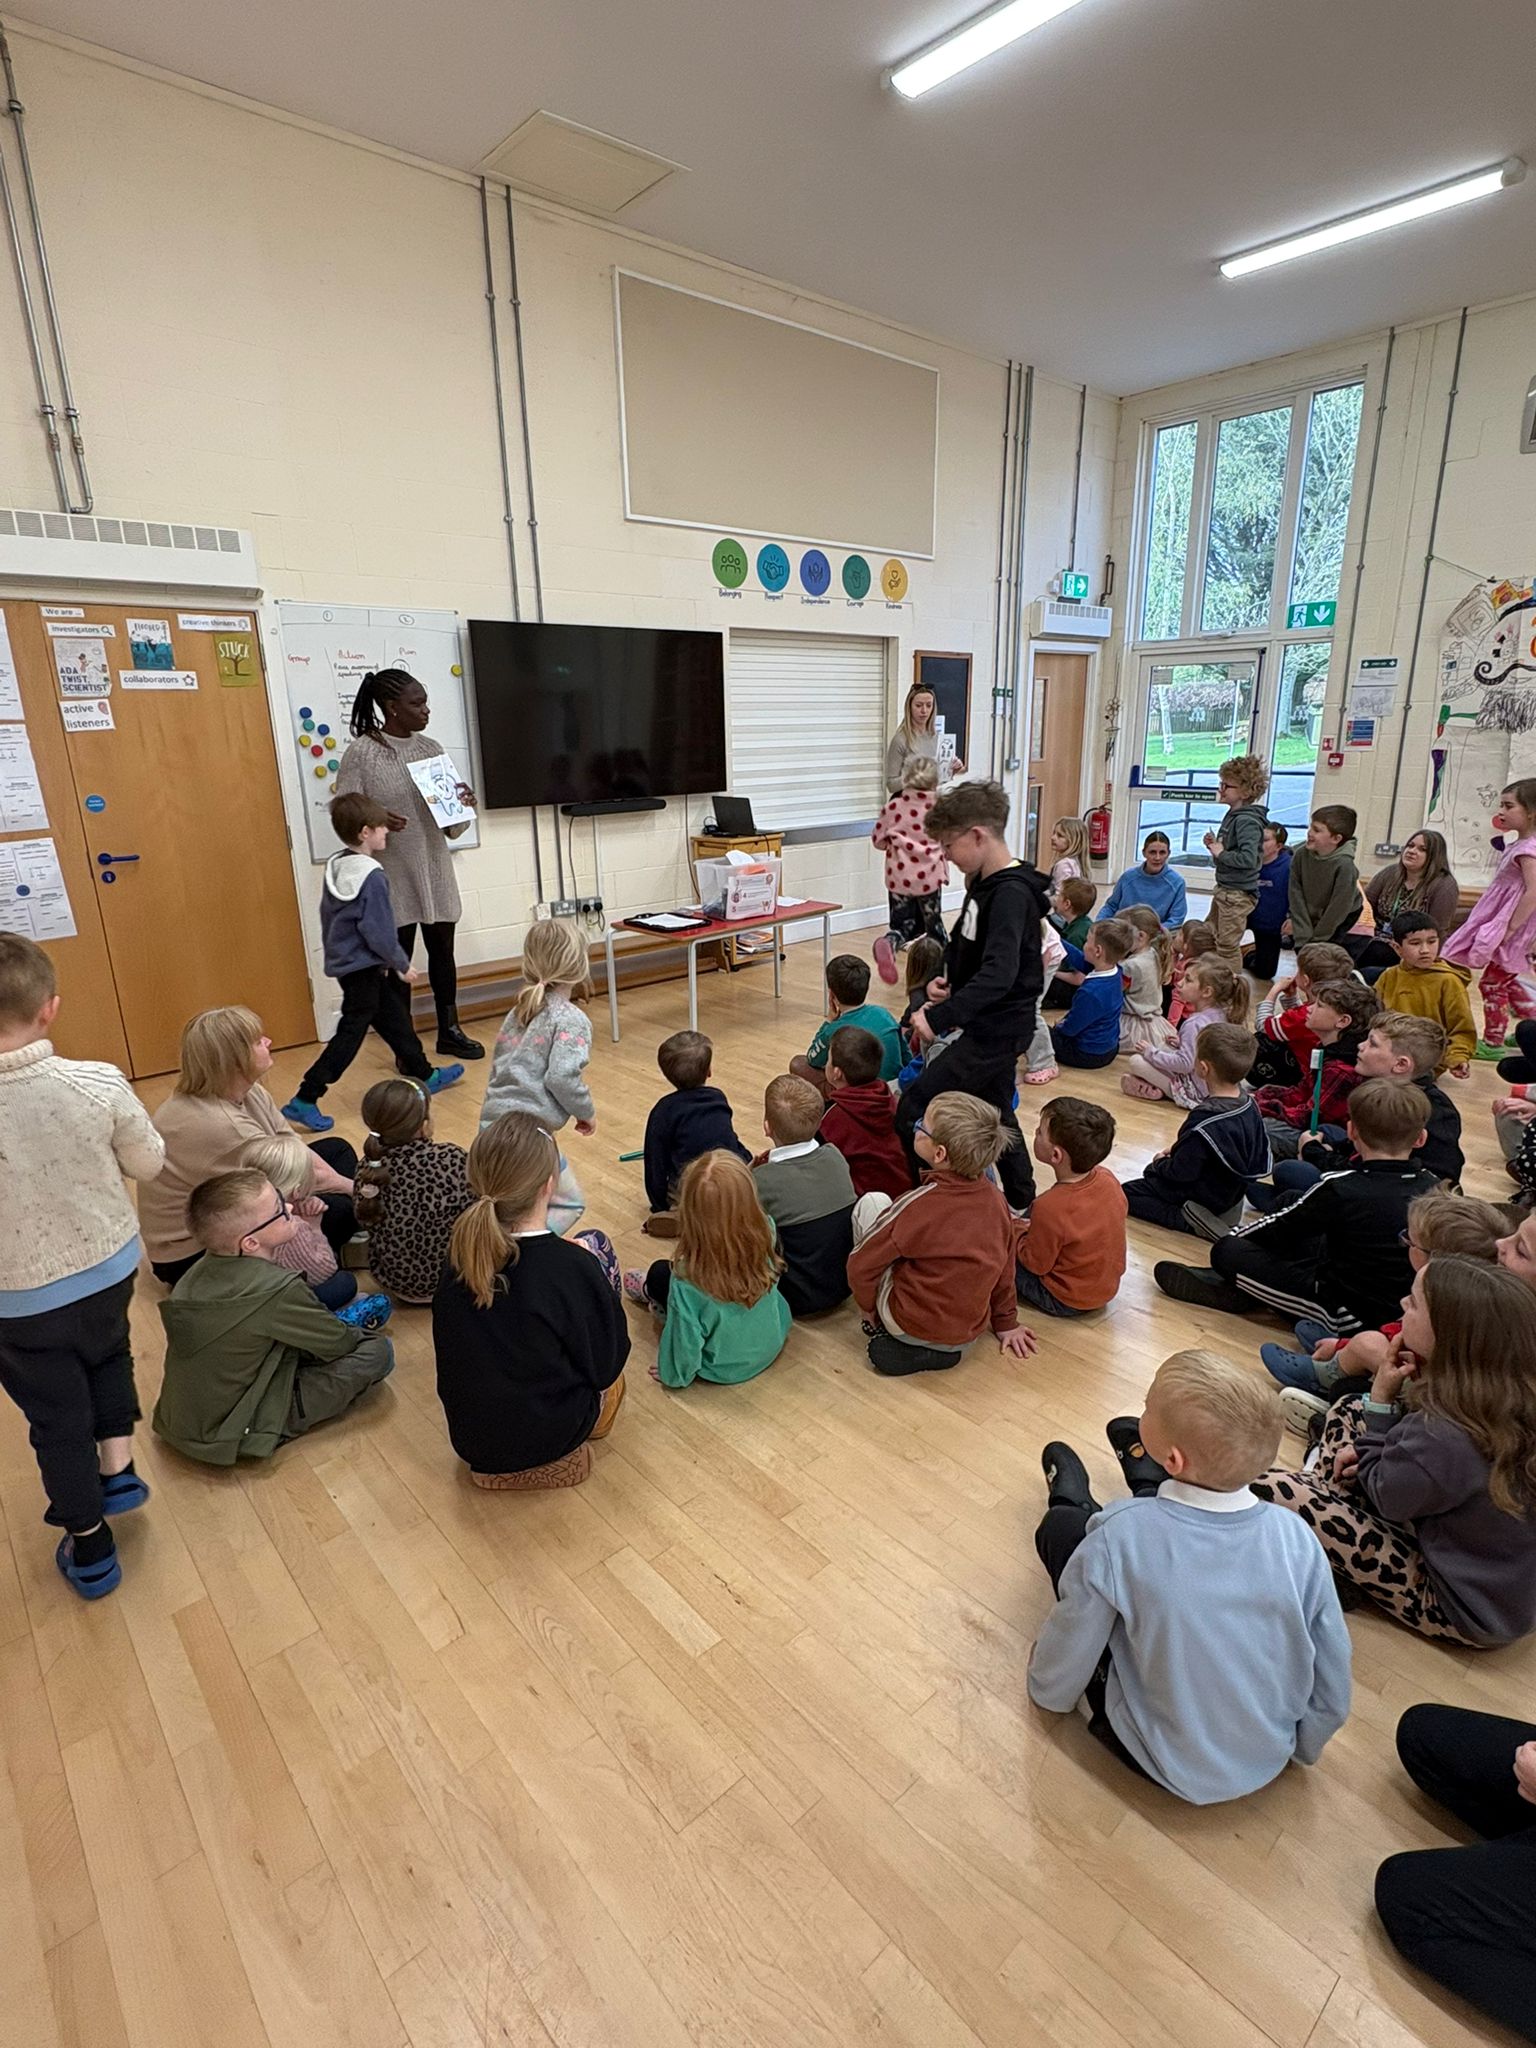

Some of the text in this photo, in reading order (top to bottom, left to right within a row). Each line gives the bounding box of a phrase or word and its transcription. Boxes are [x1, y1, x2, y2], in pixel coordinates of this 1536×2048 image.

[718, 587, 742, 599] Belonging
[764, 592, 784, 602] Respect
[800, 596, 831, 605] Independence
[45, 608, 59, 616] We
[210, 618, 237, 627] thinkers
[51, 623, 100, 634] investigators
[218, 640, 250, 658] STUCK
[287, 654, 311, 665] Group
[60, 666, 79, 675] ADA
[123, 673, 180, 684] collaborators
[62, 683, 108, 692] SCIENTIST
[63, 704, 95, 714] active
[66, 719, 111, 730] listeners
